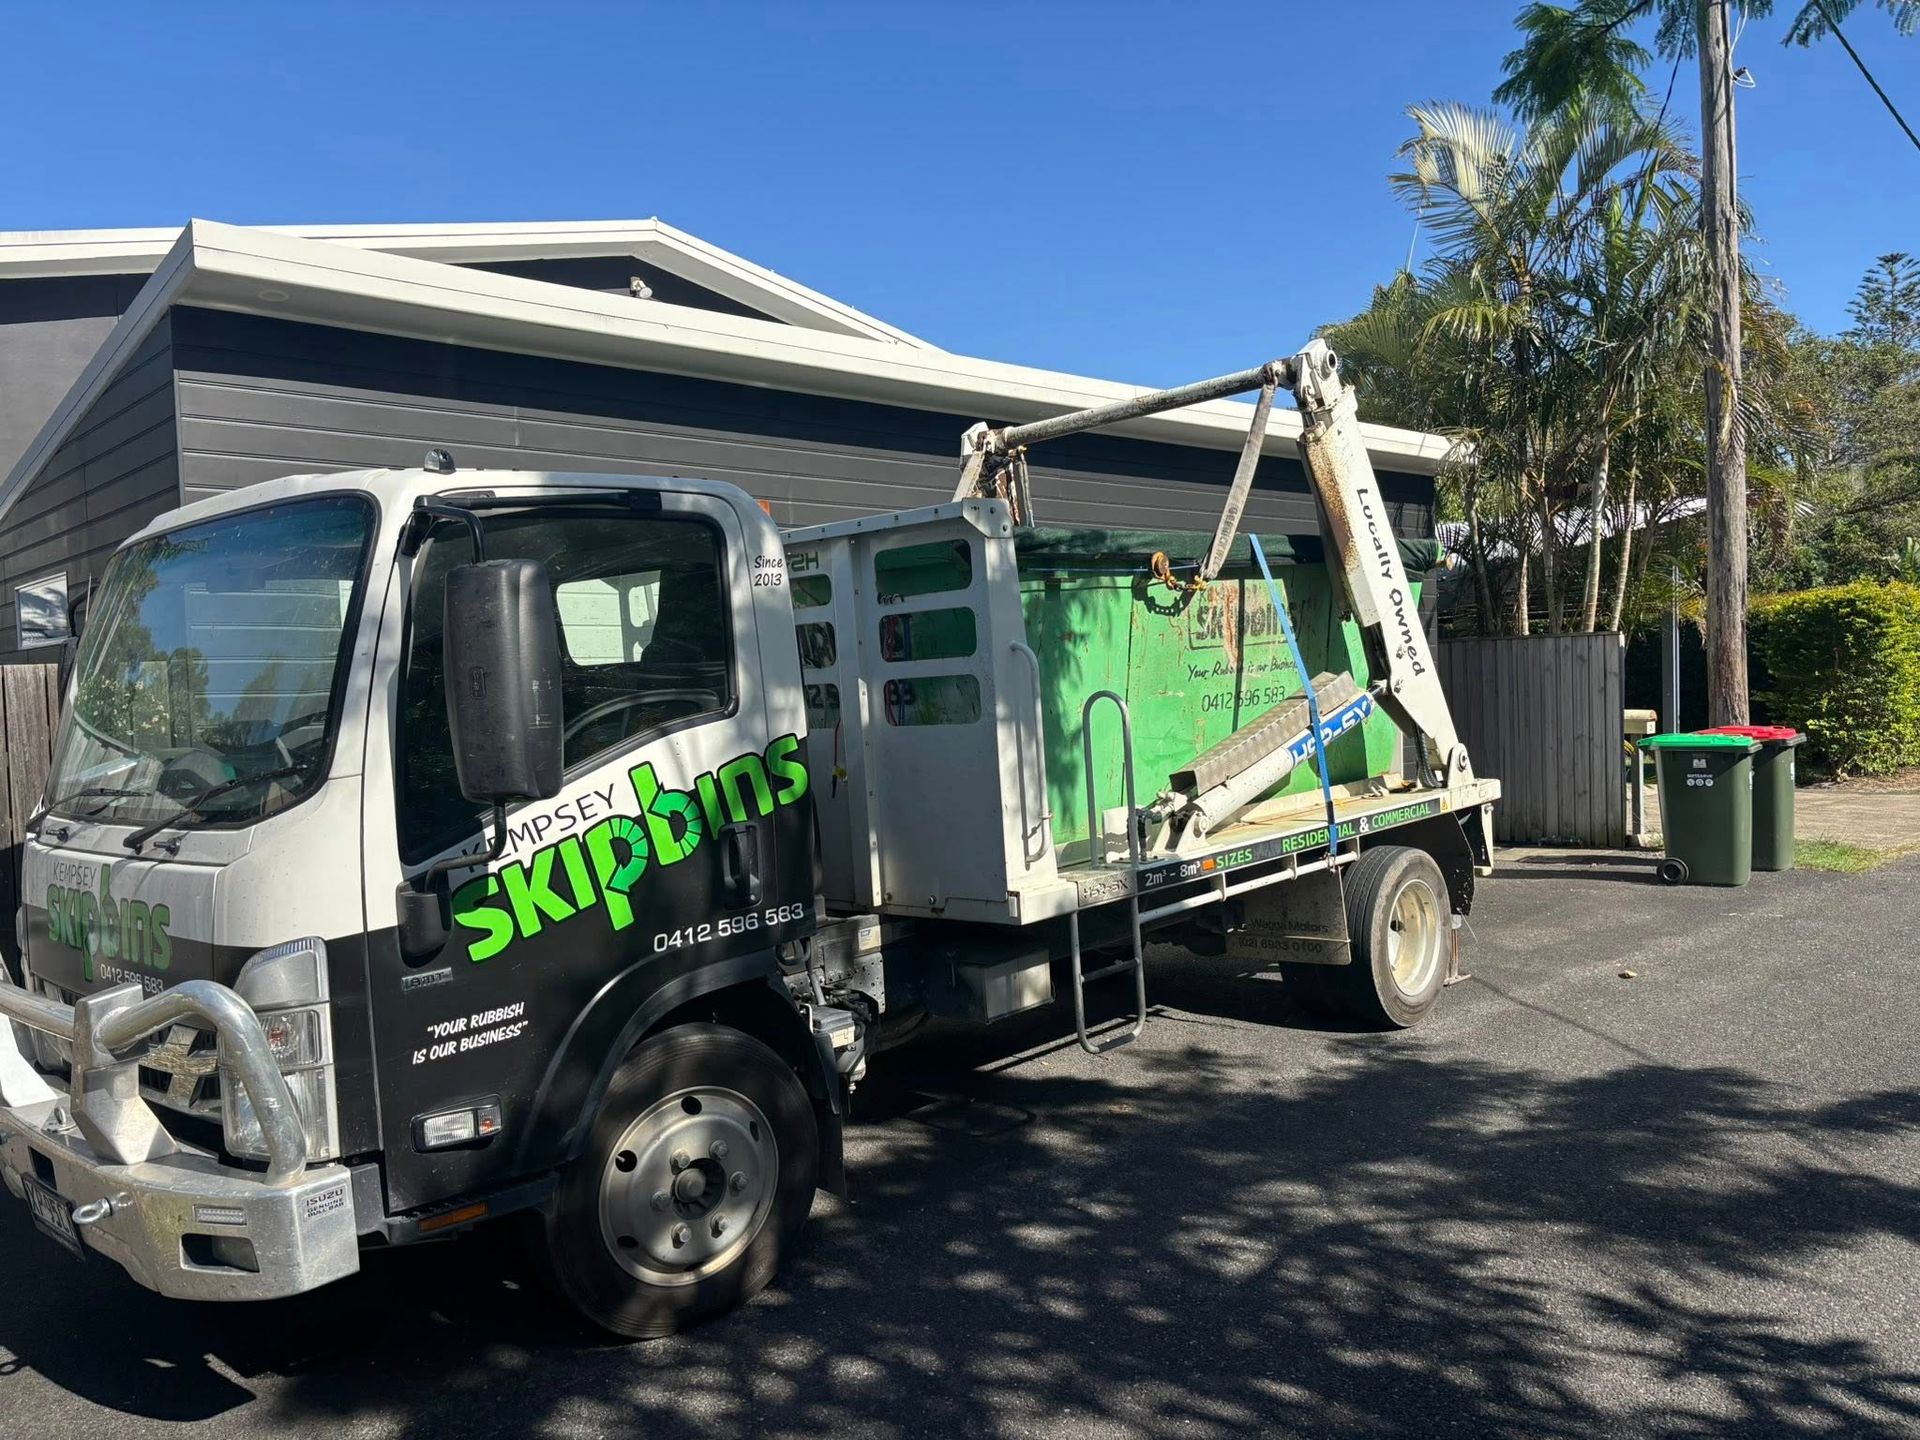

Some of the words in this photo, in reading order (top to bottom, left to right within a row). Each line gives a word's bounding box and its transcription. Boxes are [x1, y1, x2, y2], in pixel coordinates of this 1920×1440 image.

[754, 554, 784, 570] Since
[754, 573, 783, 587] 2013
[1356, 487, 1393, 580] Locally
[1389, 587, 1426, 677] Owned
[1201, 691, 1233, 713] 0412
[1238, 688, 1260, 708] 596
[1264, 685, 1286, 705] 583
[1281, 822, 1356, 853] RESIDENIAL
[1359, 816, 1369, 833] &
[1371, 802, 1431, 829] COMMERCIAL
[1216, 848, 1253, 869] SIZES
[53, 861, 98, 889] KEMPSEY
[653, 924, 712, 954] 0412
[718, 914, 759, 938] 596
[764, 903, 805, 929] 583
[100, 963, 122, 983] 0412
[144, 976, 164, 996] 583
[470, 1001, 525, 1029] RUBBISH
[412, 1048, 427, 1065] IS
[429, 1041, 457, 1060] OUR
[306, 1188, 343, 1207] ISUZU
